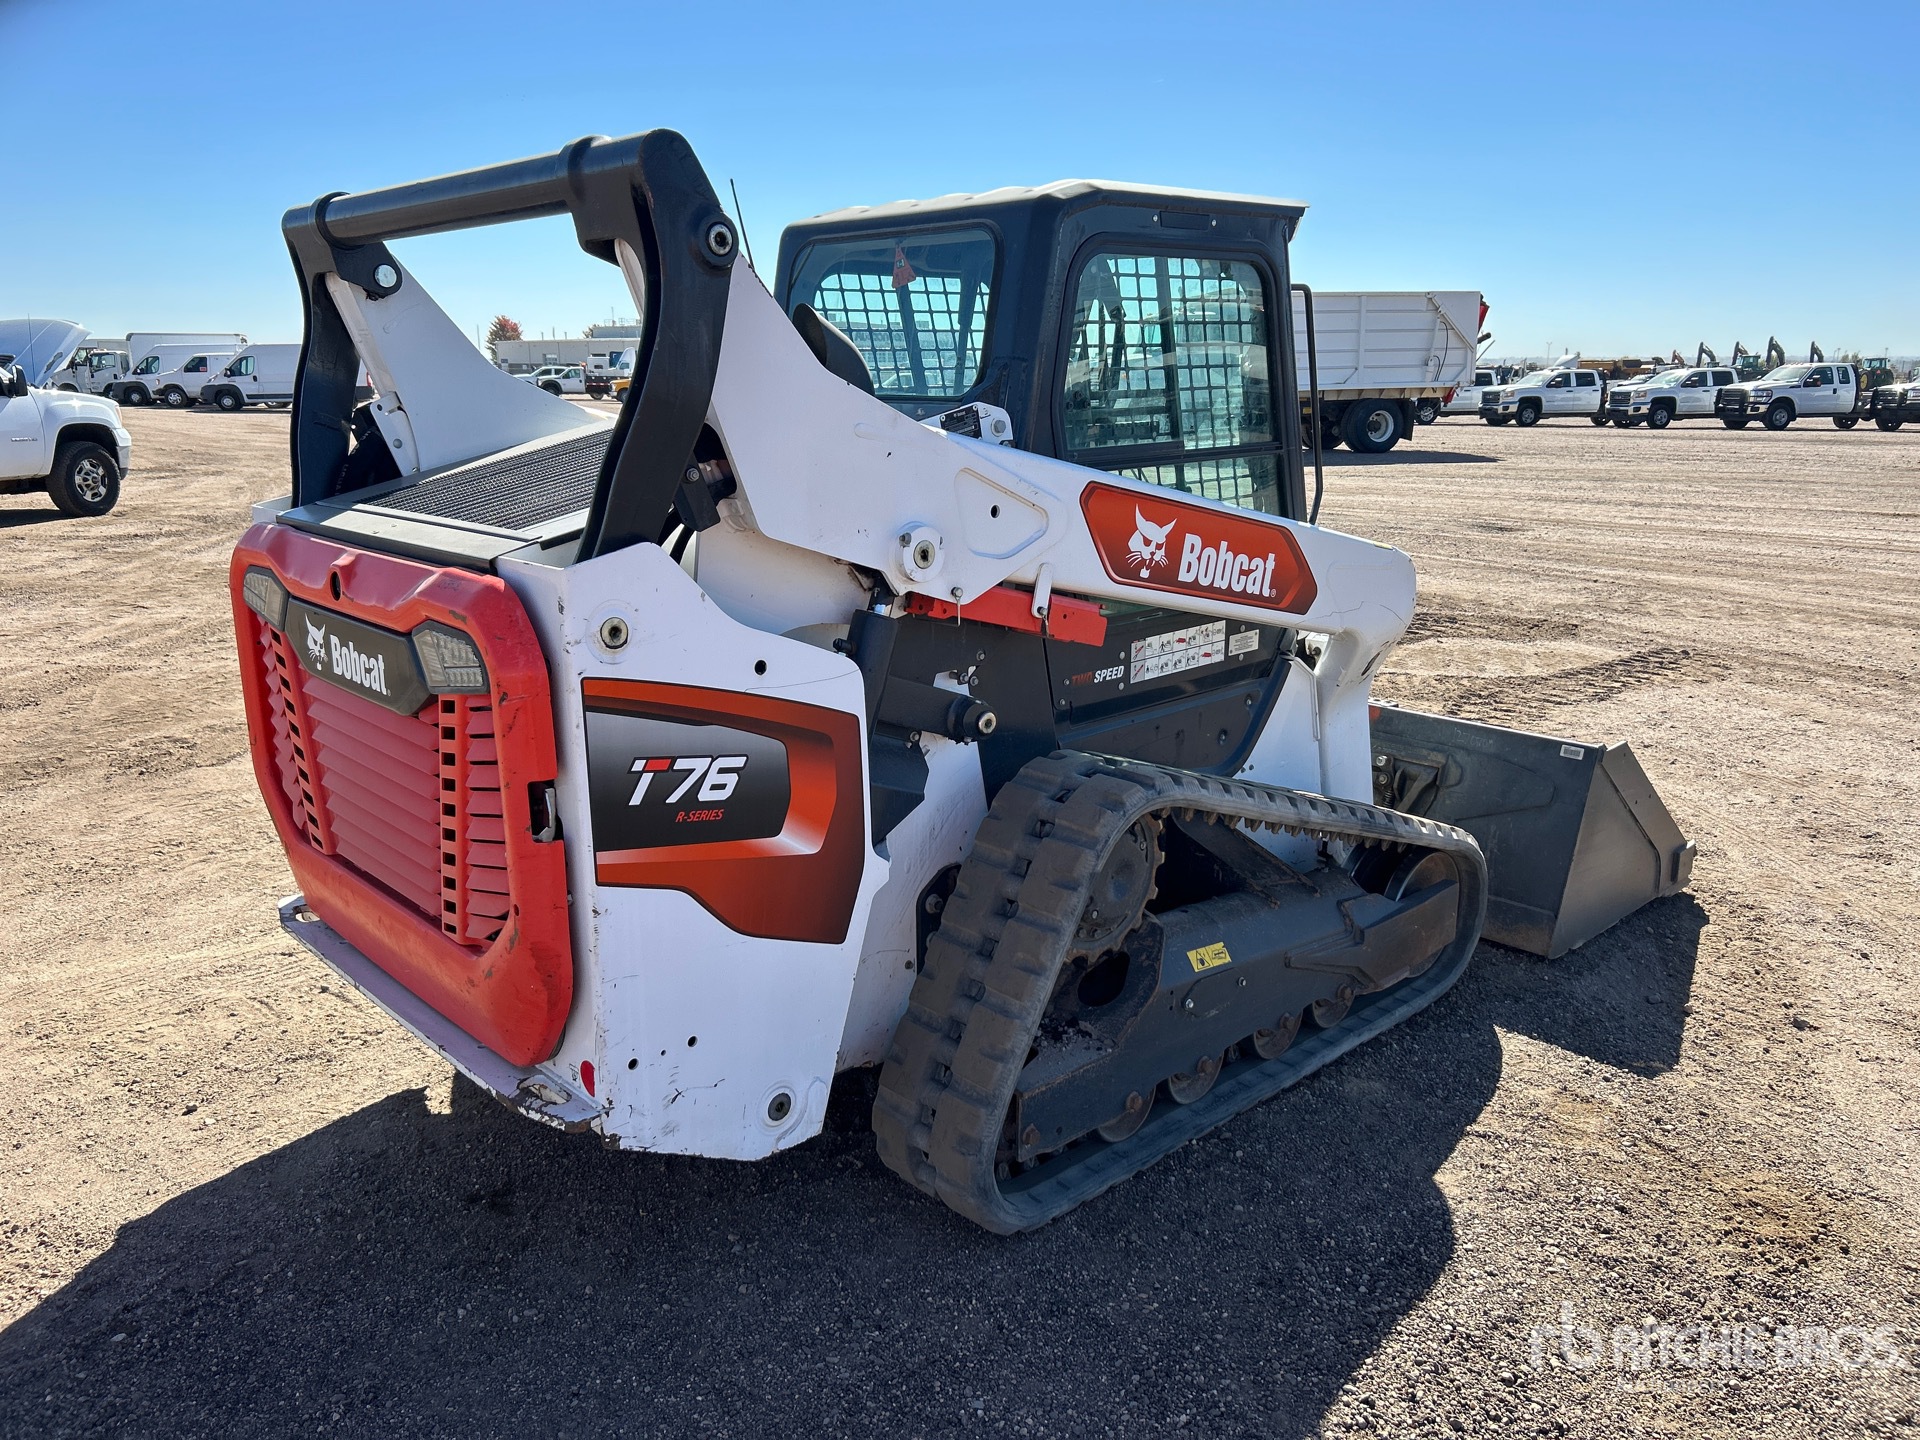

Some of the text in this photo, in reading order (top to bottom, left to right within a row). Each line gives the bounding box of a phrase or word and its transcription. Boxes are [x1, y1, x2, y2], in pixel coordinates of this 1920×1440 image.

[1177, 533, 1276, 598] Bobcat
[330, 634, 387, 696] Bobcat
[1072, 665, 1125, 686] TWO SPEED
[628, 756, 748, 806] T76
[675, 808, 725, 823] R-SERIES
